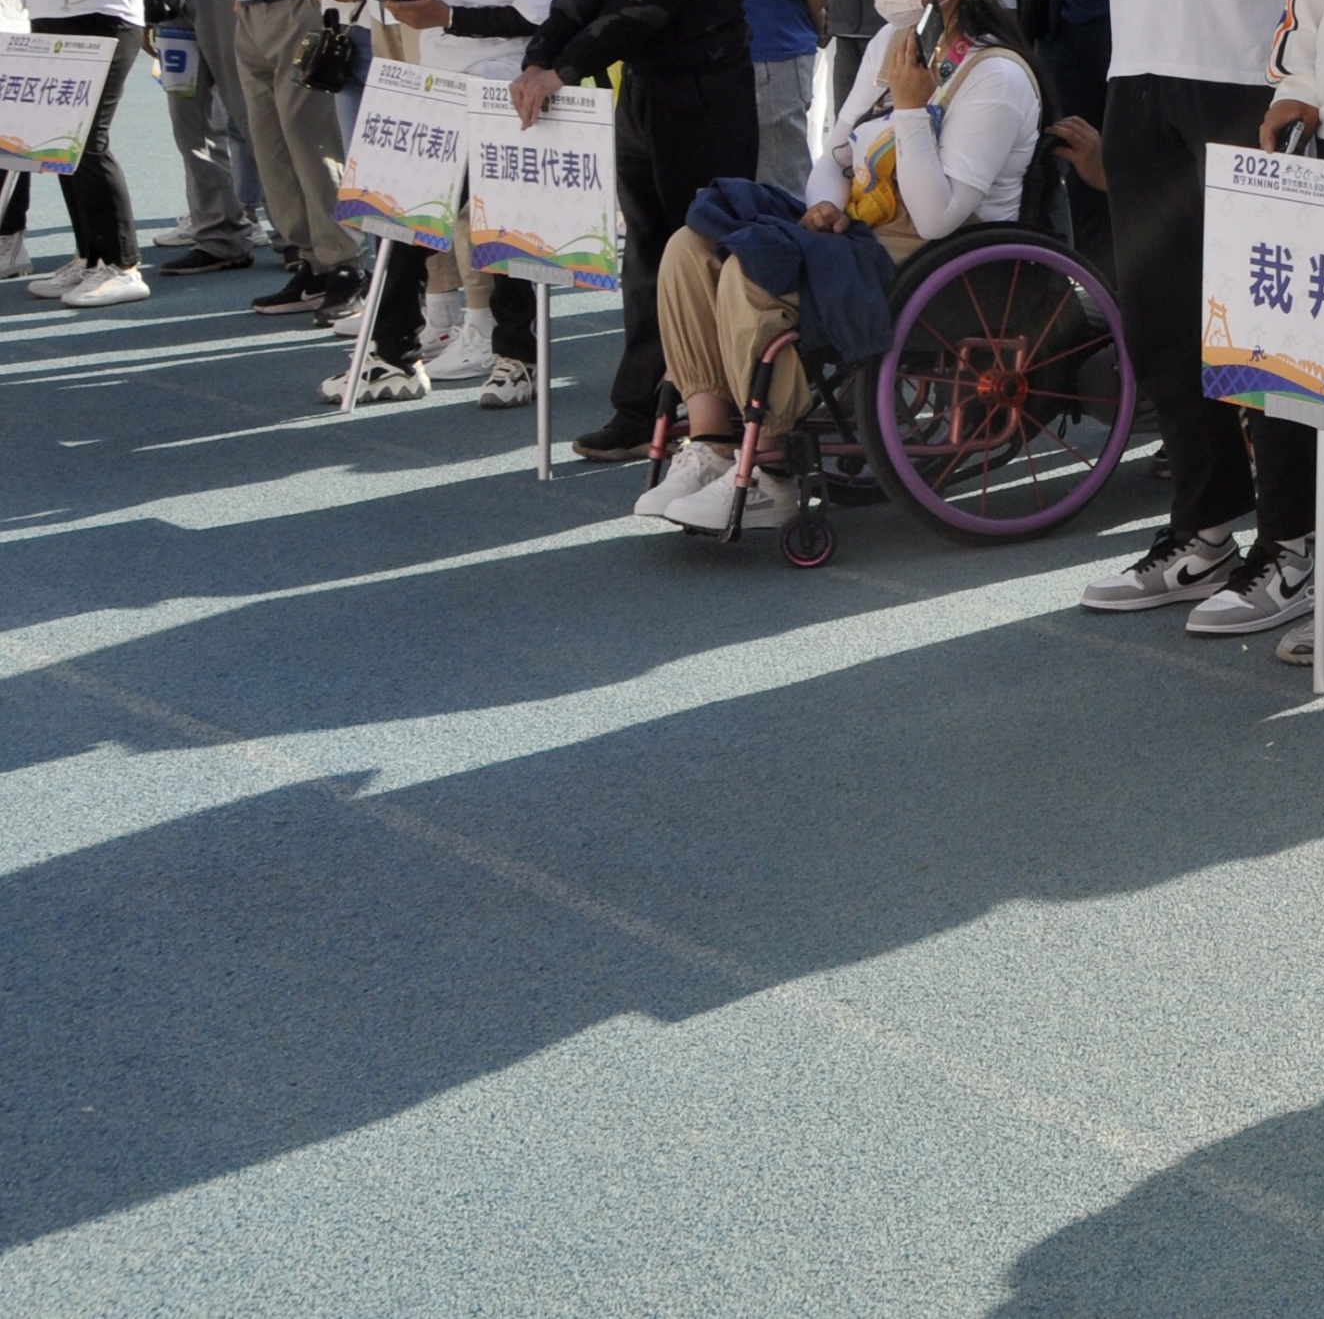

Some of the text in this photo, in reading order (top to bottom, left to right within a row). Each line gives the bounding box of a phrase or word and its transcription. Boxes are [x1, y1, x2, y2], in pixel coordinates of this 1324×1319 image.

[482, 86, 509, 102] 2022
[362, 111, 459, 163] 城东区代表队
[480, 142, 602, 191] 湟源县代表队
[1233, 154, 1280, 179] 2022
